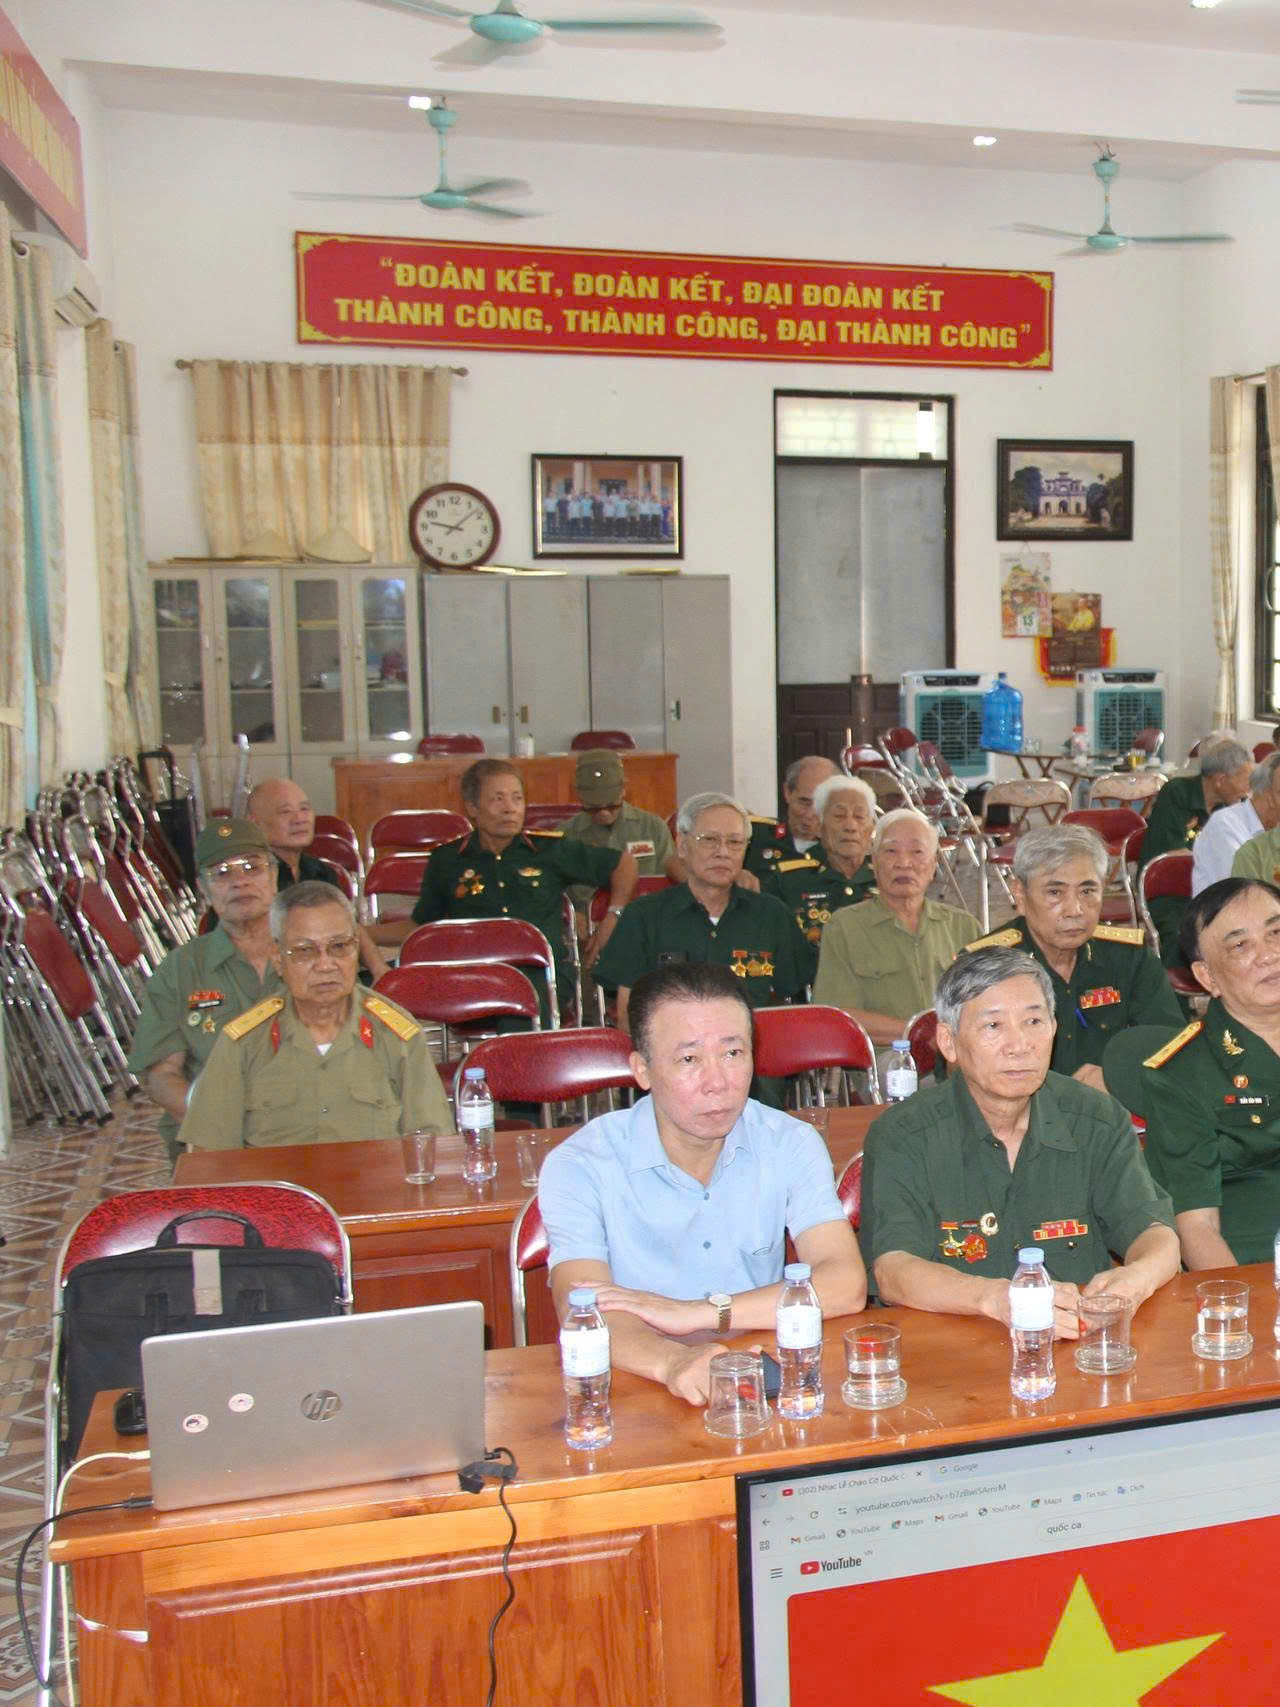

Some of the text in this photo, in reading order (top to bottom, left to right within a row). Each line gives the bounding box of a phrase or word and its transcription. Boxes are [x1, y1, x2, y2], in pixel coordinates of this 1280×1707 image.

[496, 263, 563, 298] KẾT,
[573, 270, 659, 300] ĐOÀN
[670, 272, 734, 305] KẾT,
[743, 281, 793, 310] ĐẠI
[803, 280, 883, 309] ĐOÀN
[892, 282, 945, 312] KẾT
[334, 296, 444, 326] THÀNH
[455, 301, 553, 334] CÔNG,
[563, 306, 666, 337] THÀNH
[676, 311, 768, 344] CÔNG,
[777, 318, 826, 347] ĐẠI
[836, 318, 932, 346] THÀNH
[436, 499, 446, 508] 11
[449, 496, 461, 505] 12
[426, 510, 438, 519] 10
[421, 522, 428, 531] 9
[481, 525, 488, 534] 3
[451, 552, 458, 560] 6
[466, 549, 472, 557] 5
[305, 1390, 340, 1421] hp
[953, 1463, 978, 1474] Google
[991, 1503, 1021, 1513] YouTube
[948, 1511, 968, 1521] Gmail
[904, 1518, 924, 1529] Maps
[1047, 1521, 1082, 1535] quốc ca
[851, 1525, 881, 1535] YouTube
[804, 1533, 826, 1542] Gmail
[820, 1557, 862, 1573] YouTube
